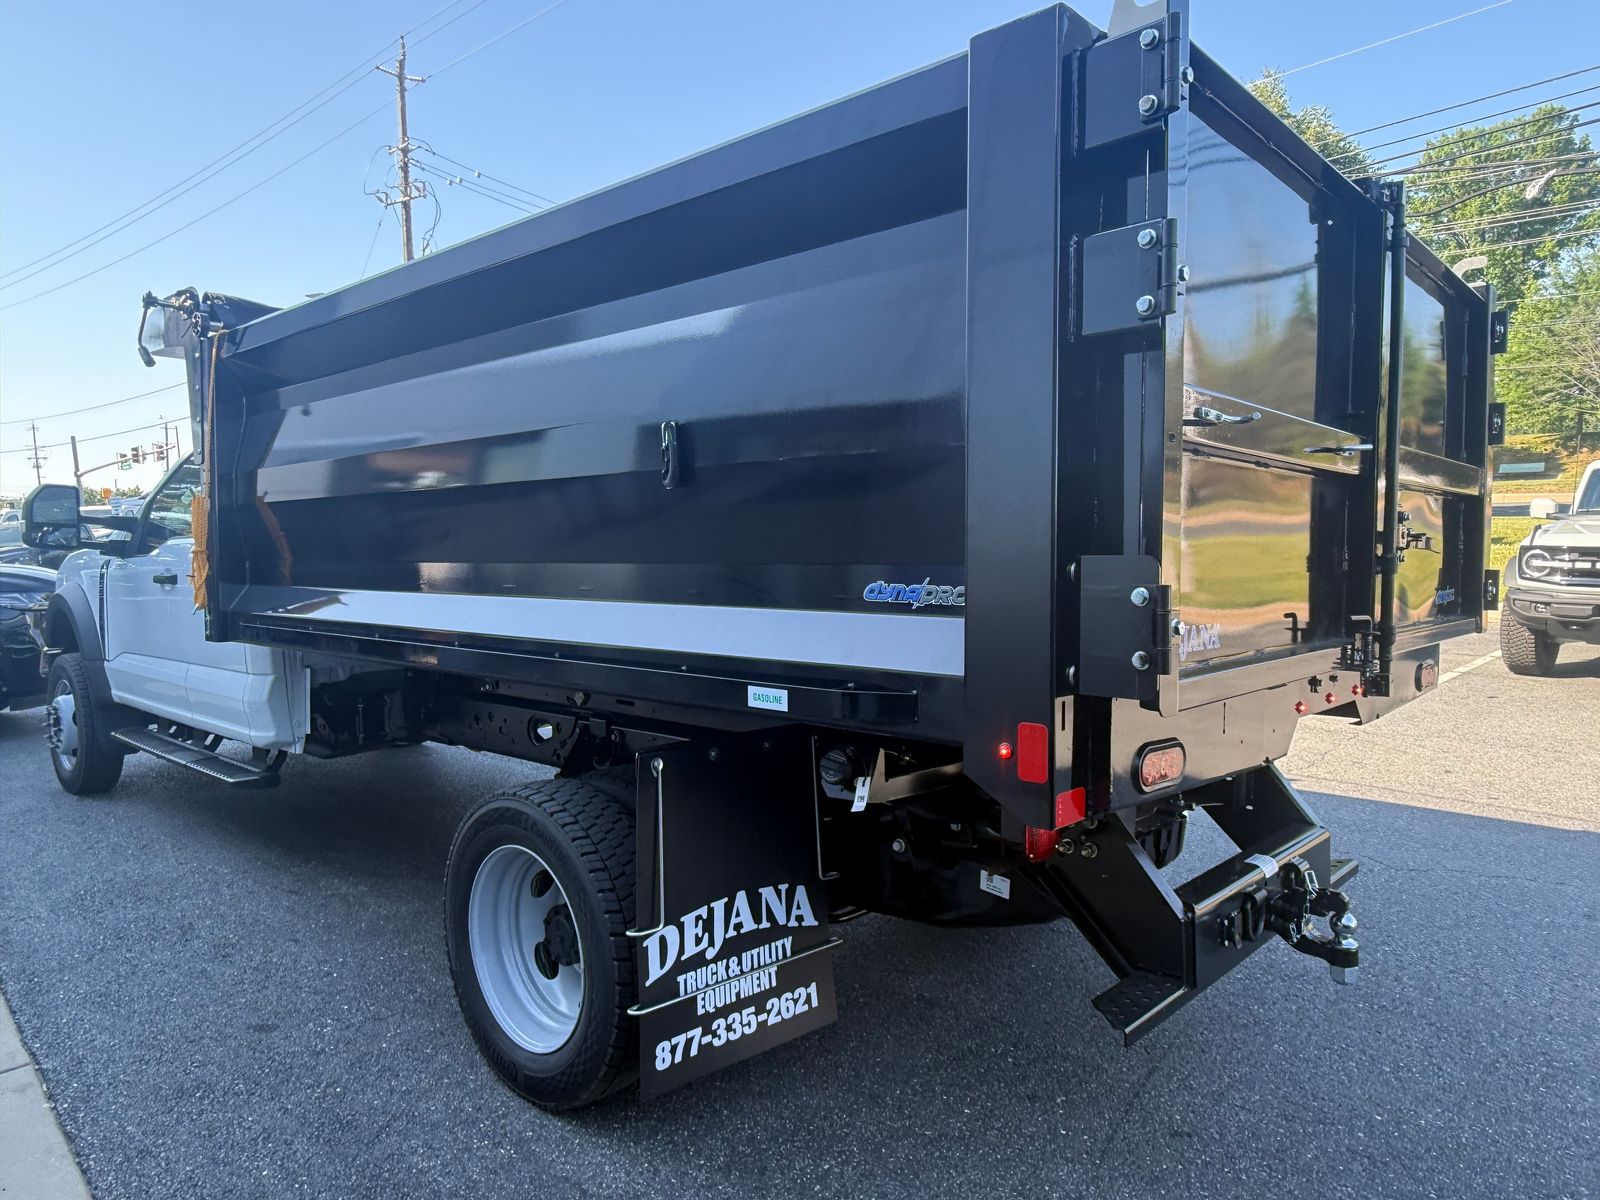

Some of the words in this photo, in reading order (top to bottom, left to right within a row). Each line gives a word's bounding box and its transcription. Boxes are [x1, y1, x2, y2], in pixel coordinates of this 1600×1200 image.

[752, 692, 783, 705] GASOLINE
[643, 883, 819, 987] DEJANA
[655, 981, 819, 1071] 877-335-2621
[697, 966, 778, 1016] EQUIPMENT
